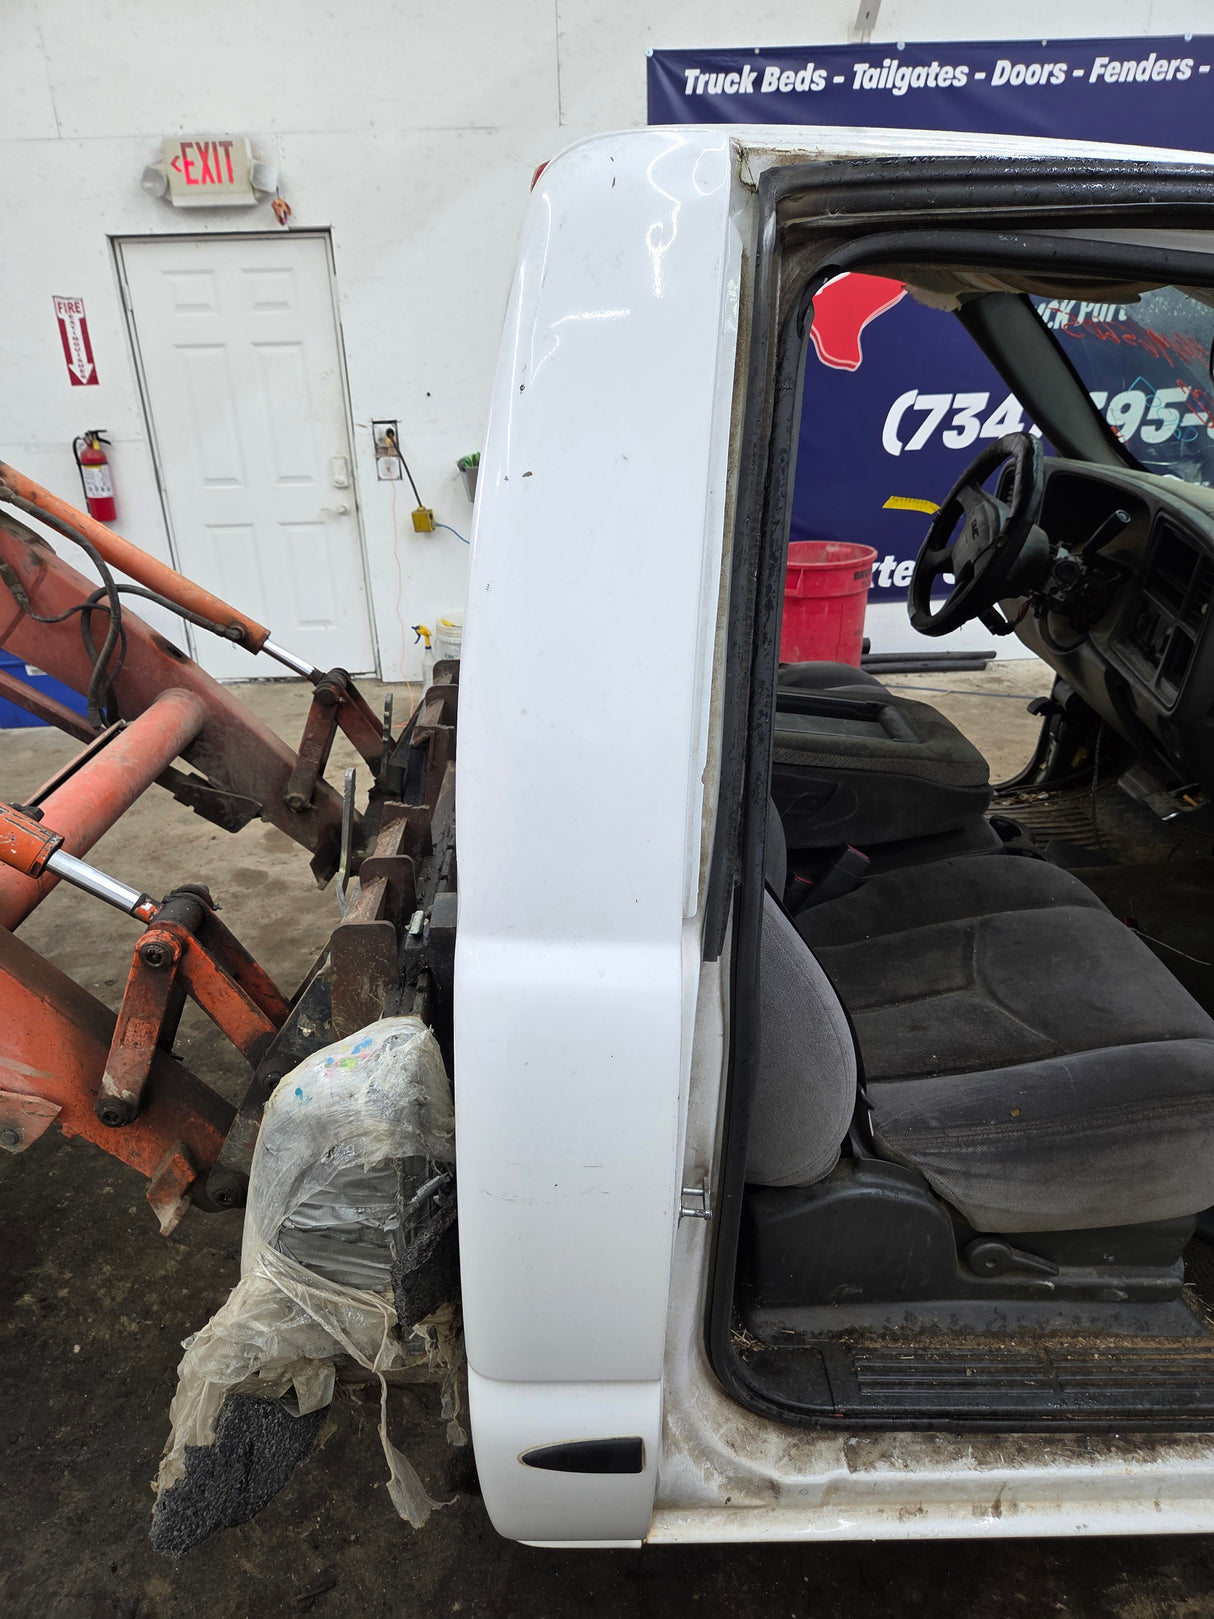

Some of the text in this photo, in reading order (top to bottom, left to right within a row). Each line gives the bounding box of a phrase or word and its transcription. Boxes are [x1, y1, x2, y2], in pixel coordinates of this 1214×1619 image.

[685, 65, 757, 95] Truck
[761, 63, 827, 93] Beds
[853, 58, 969, 96] Tailgates
[991, 59, 1067, 86] Doors
[1089, 52, 1194, 84] Fenders
[180, 141, 234, 185] EXIT
[57, 302, 82, 314] FIRE
[882, 389, 1043, 457] (734
